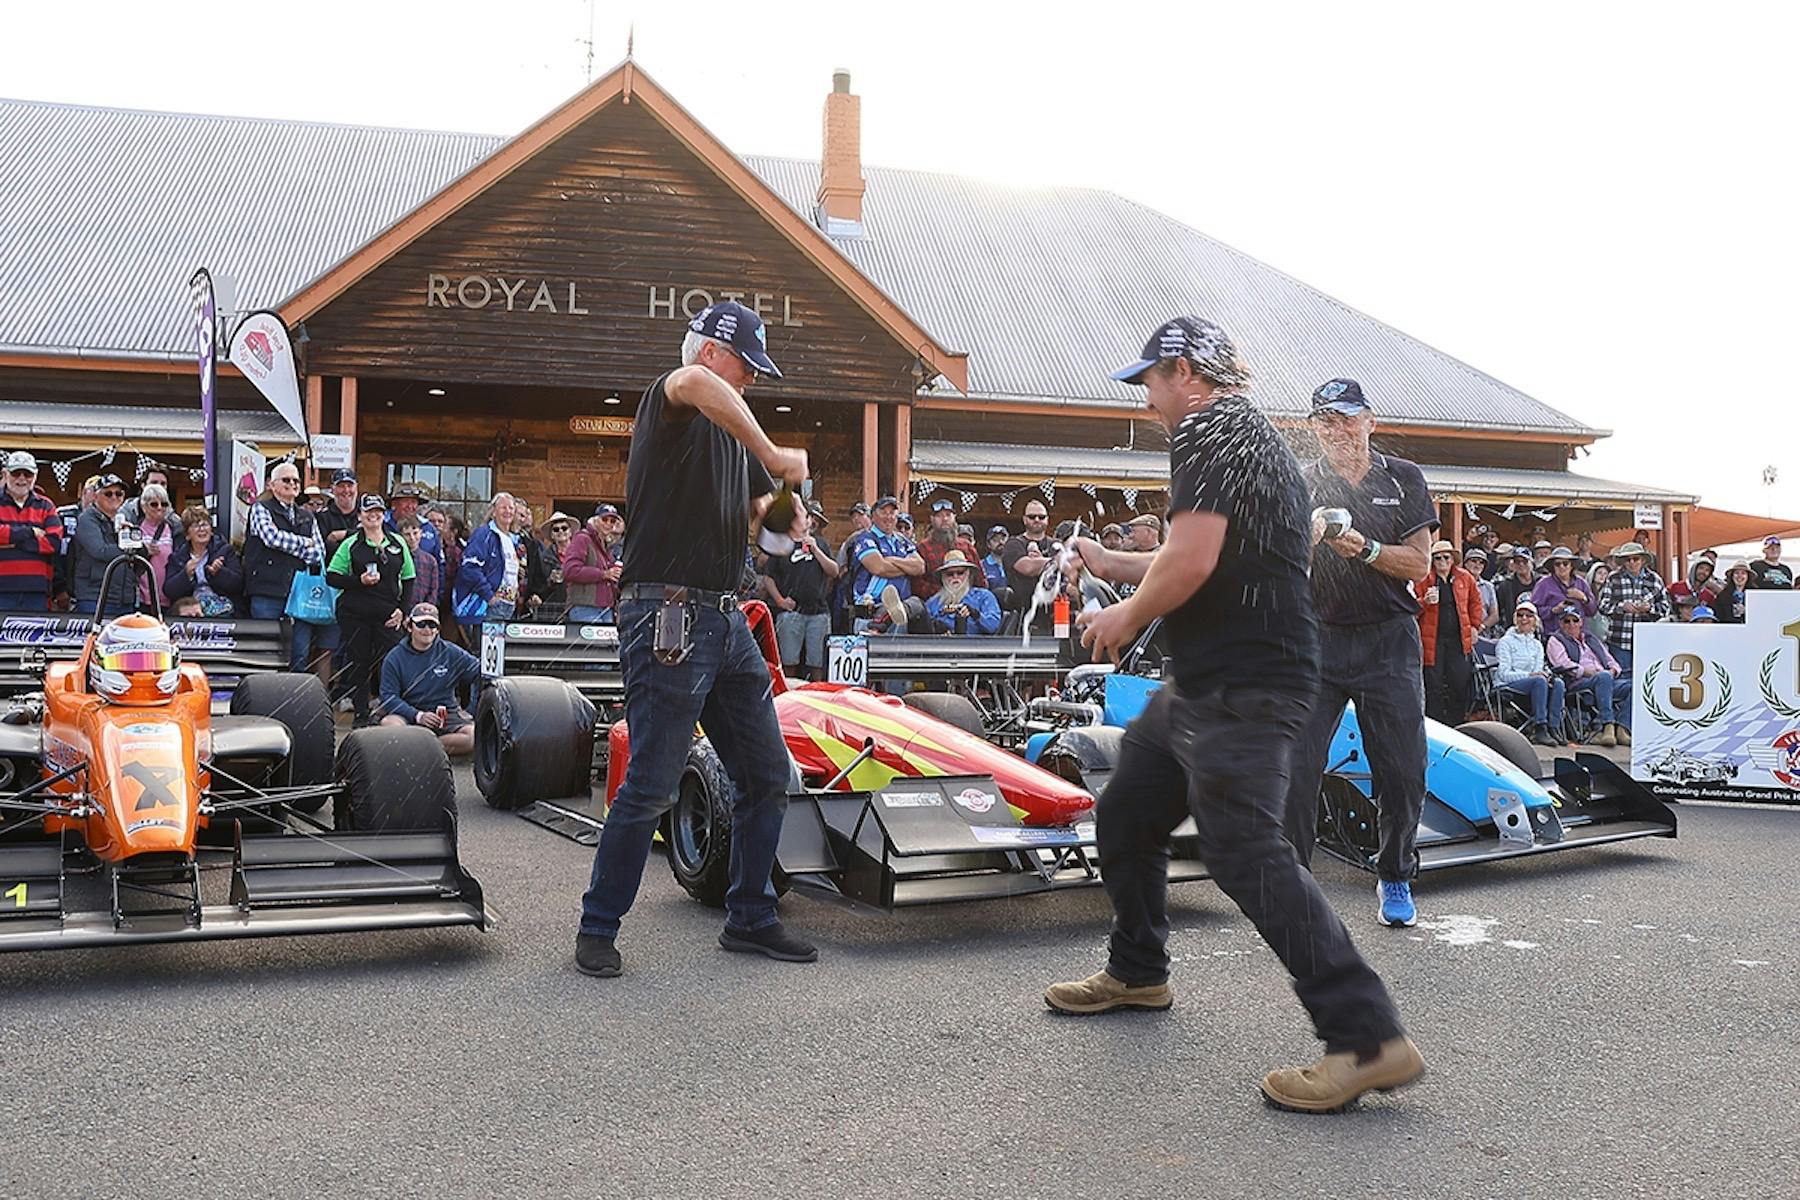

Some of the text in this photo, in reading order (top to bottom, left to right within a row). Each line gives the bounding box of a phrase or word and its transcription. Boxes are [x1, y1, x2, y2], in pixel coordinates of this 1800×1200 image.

[427, 273, 589, 315] ROYAL
[648, 286, 803, 327] HOTEL
[312, 445, 350, 454] SMOKING
[324, 437, 337, 445] NO
[522, 627, 563, 636] Castrol
[485, 644, 498, 673] 99
[834, 656, 863, 682] 100
[1669, 653, 1704, 710] 3
[1652, 785, 1700, 797] Celebrating
[1701, 788, 1744, 798] Australian
[1745, 790, 1772, 799] Grand
[1773, 791, 1790, 800] Prix
[4, 882, 27, 908] 1
